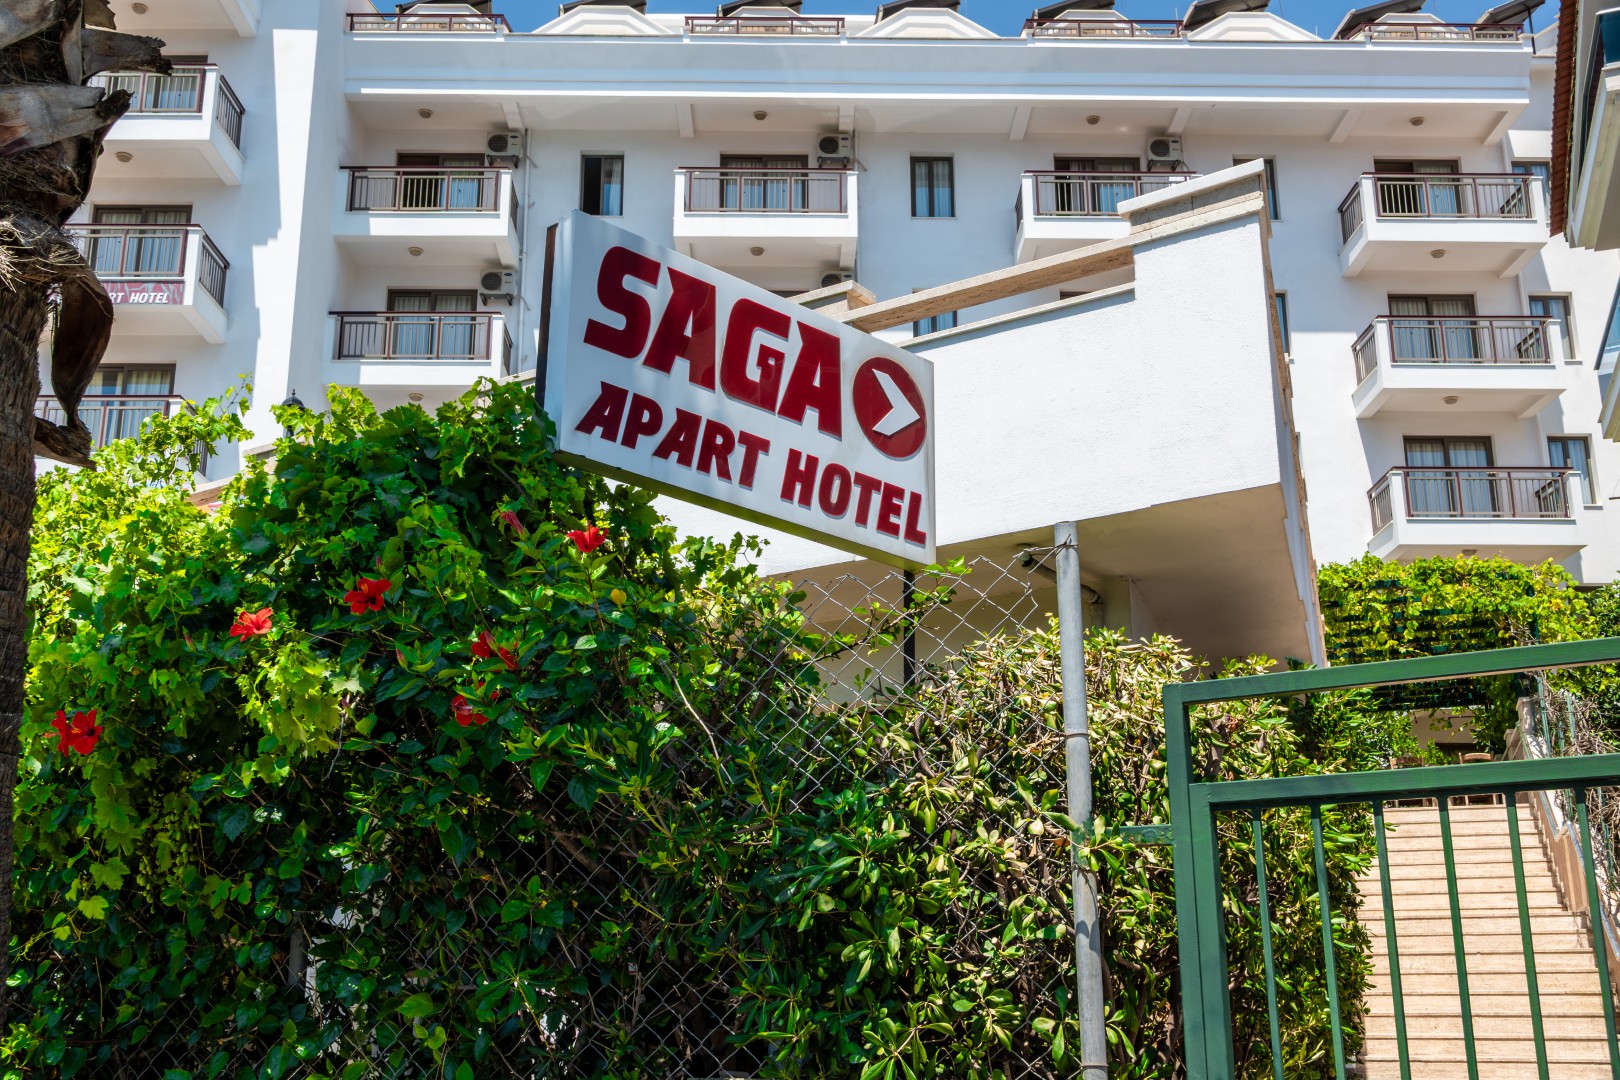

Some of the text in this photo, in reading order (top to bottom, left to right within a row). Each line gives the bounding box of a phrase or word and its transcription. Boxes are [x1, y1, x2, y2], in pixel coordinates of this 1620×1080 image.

[129, 292, 169, 304] HOTEL
[583, 245, 843, 440] SAGA
[575, 381, 927, 545] APART HOTEL
